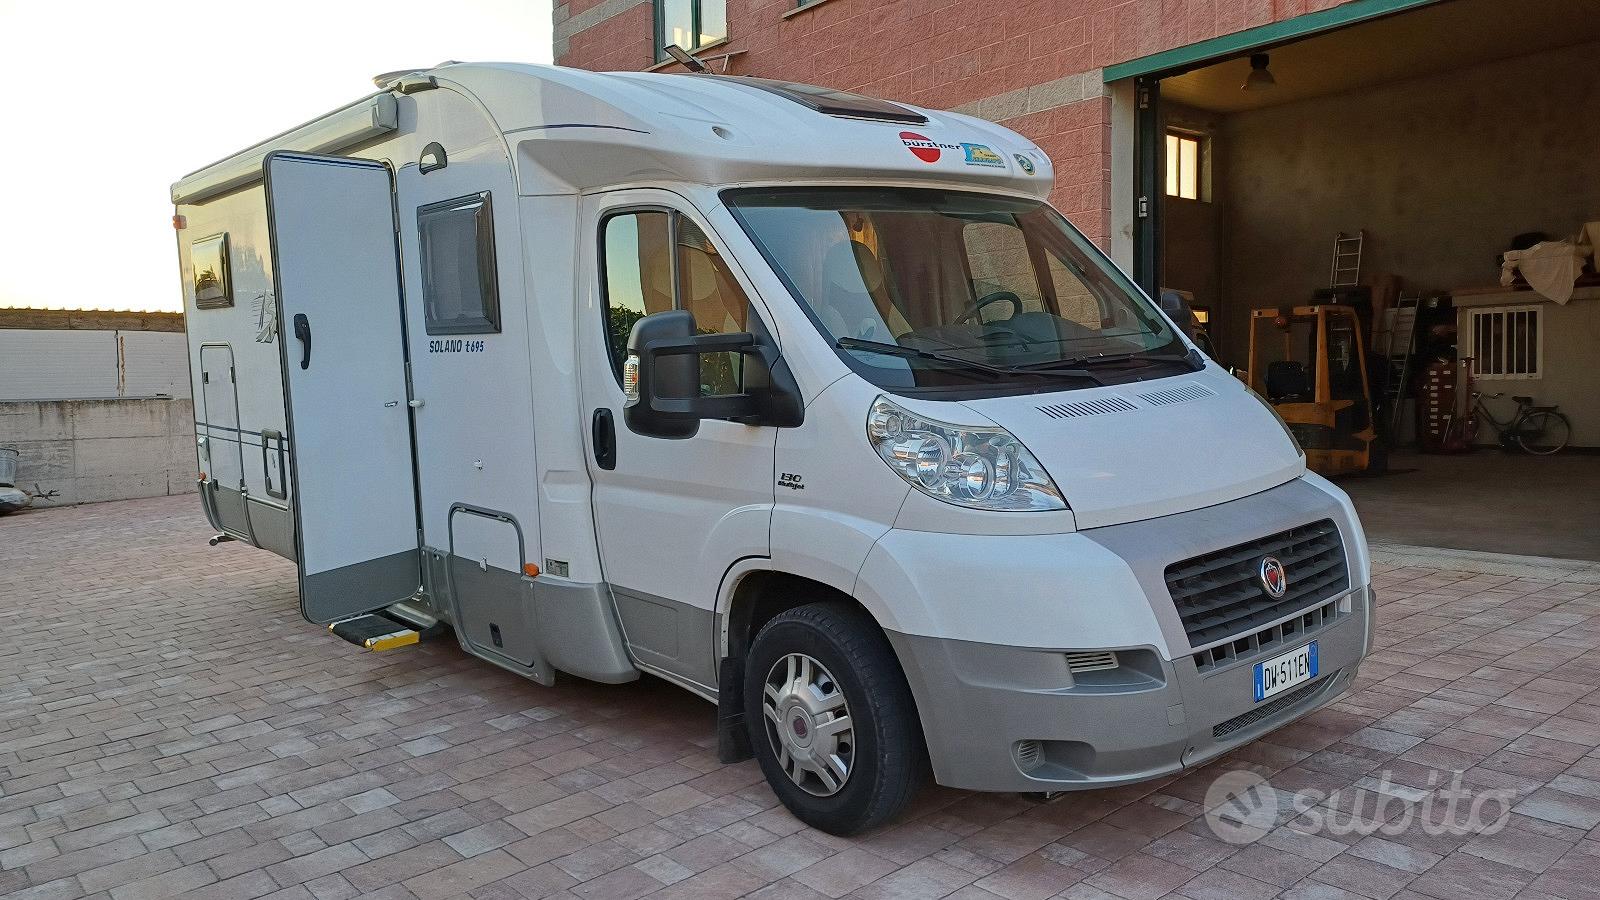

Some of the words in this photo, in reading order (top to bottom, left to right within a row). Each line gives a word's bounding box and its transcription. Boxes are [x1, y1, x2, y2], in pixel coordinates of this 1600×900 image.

[902, 139, 961, 150] bürstner
[429, 340, 462, 353] SOLANO
[465, 340, 484, 353] t695
[780, 472, 802, 483] 130
